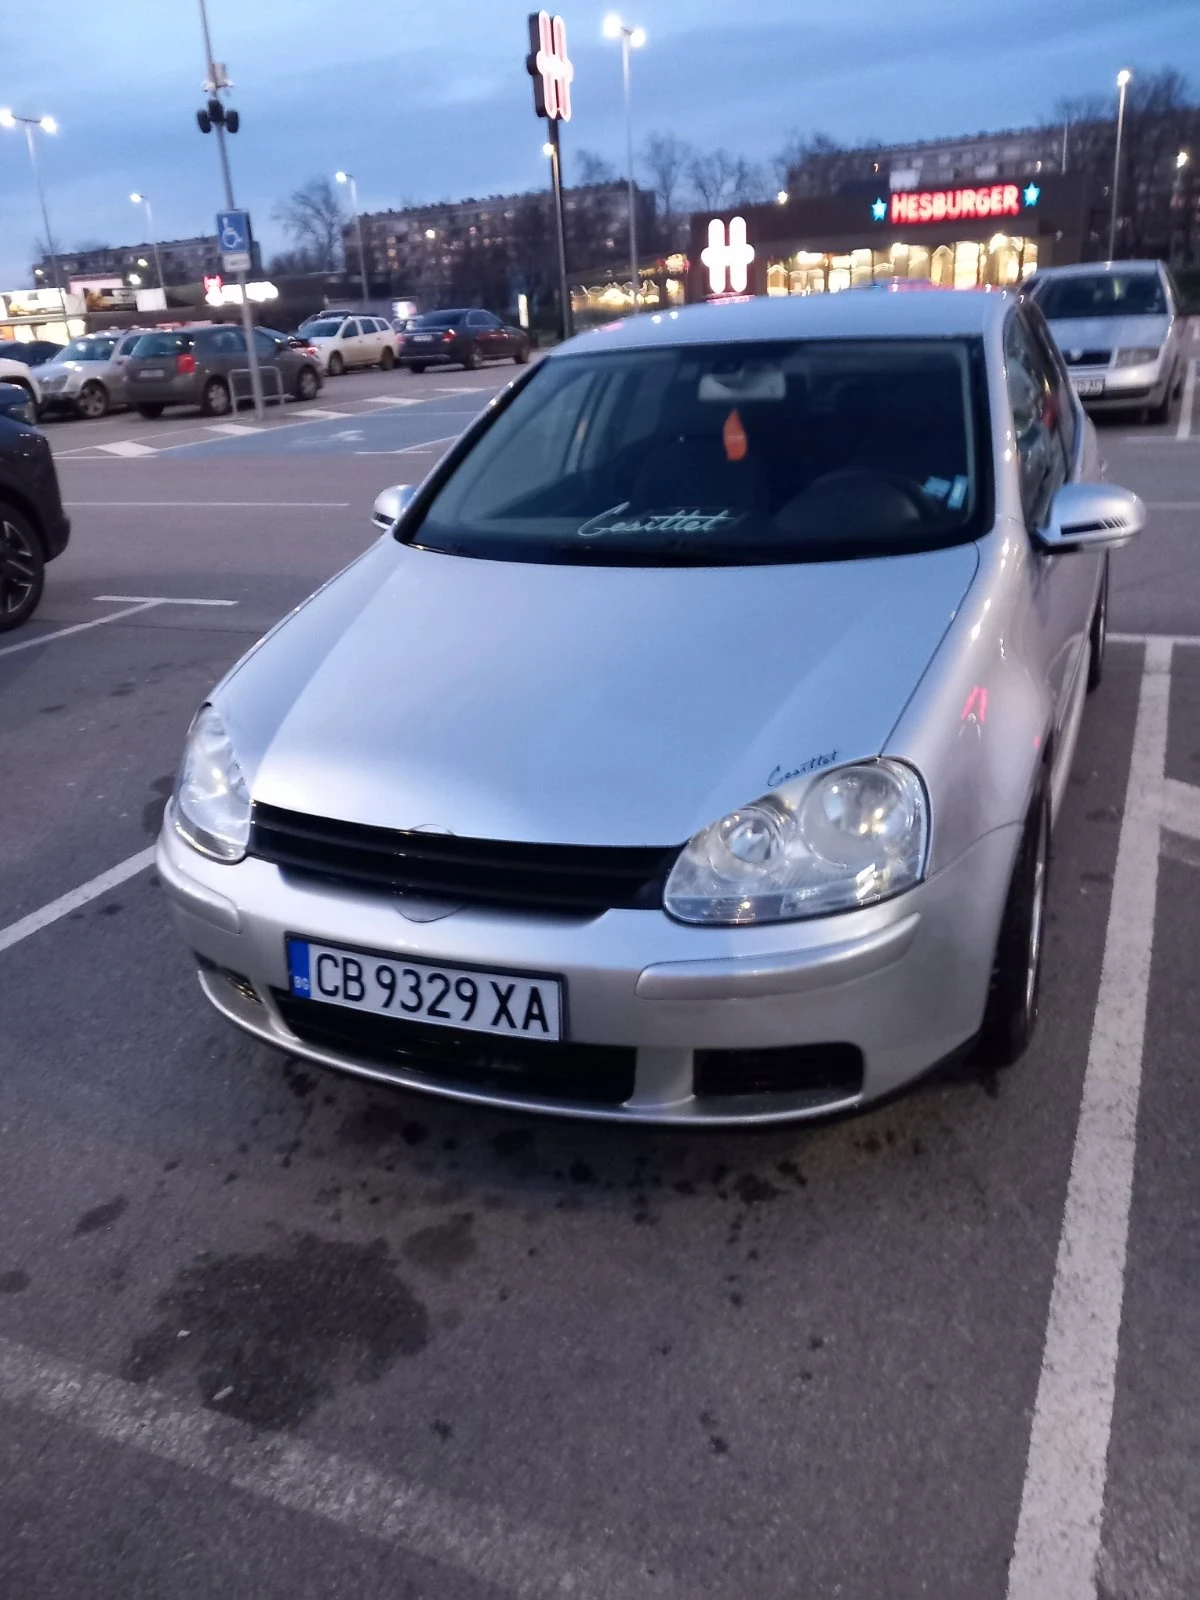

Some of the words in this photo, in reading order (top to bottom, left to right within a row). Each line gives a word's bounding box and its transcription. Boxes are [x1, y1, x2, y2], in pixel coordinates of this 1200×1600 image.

[890, 184, 1020, 225] HESBURGER
[316, 952, 365, 1002] CB
[375, 964, 478, 1022] 9329
[489, 980, 549, 1033] XA
